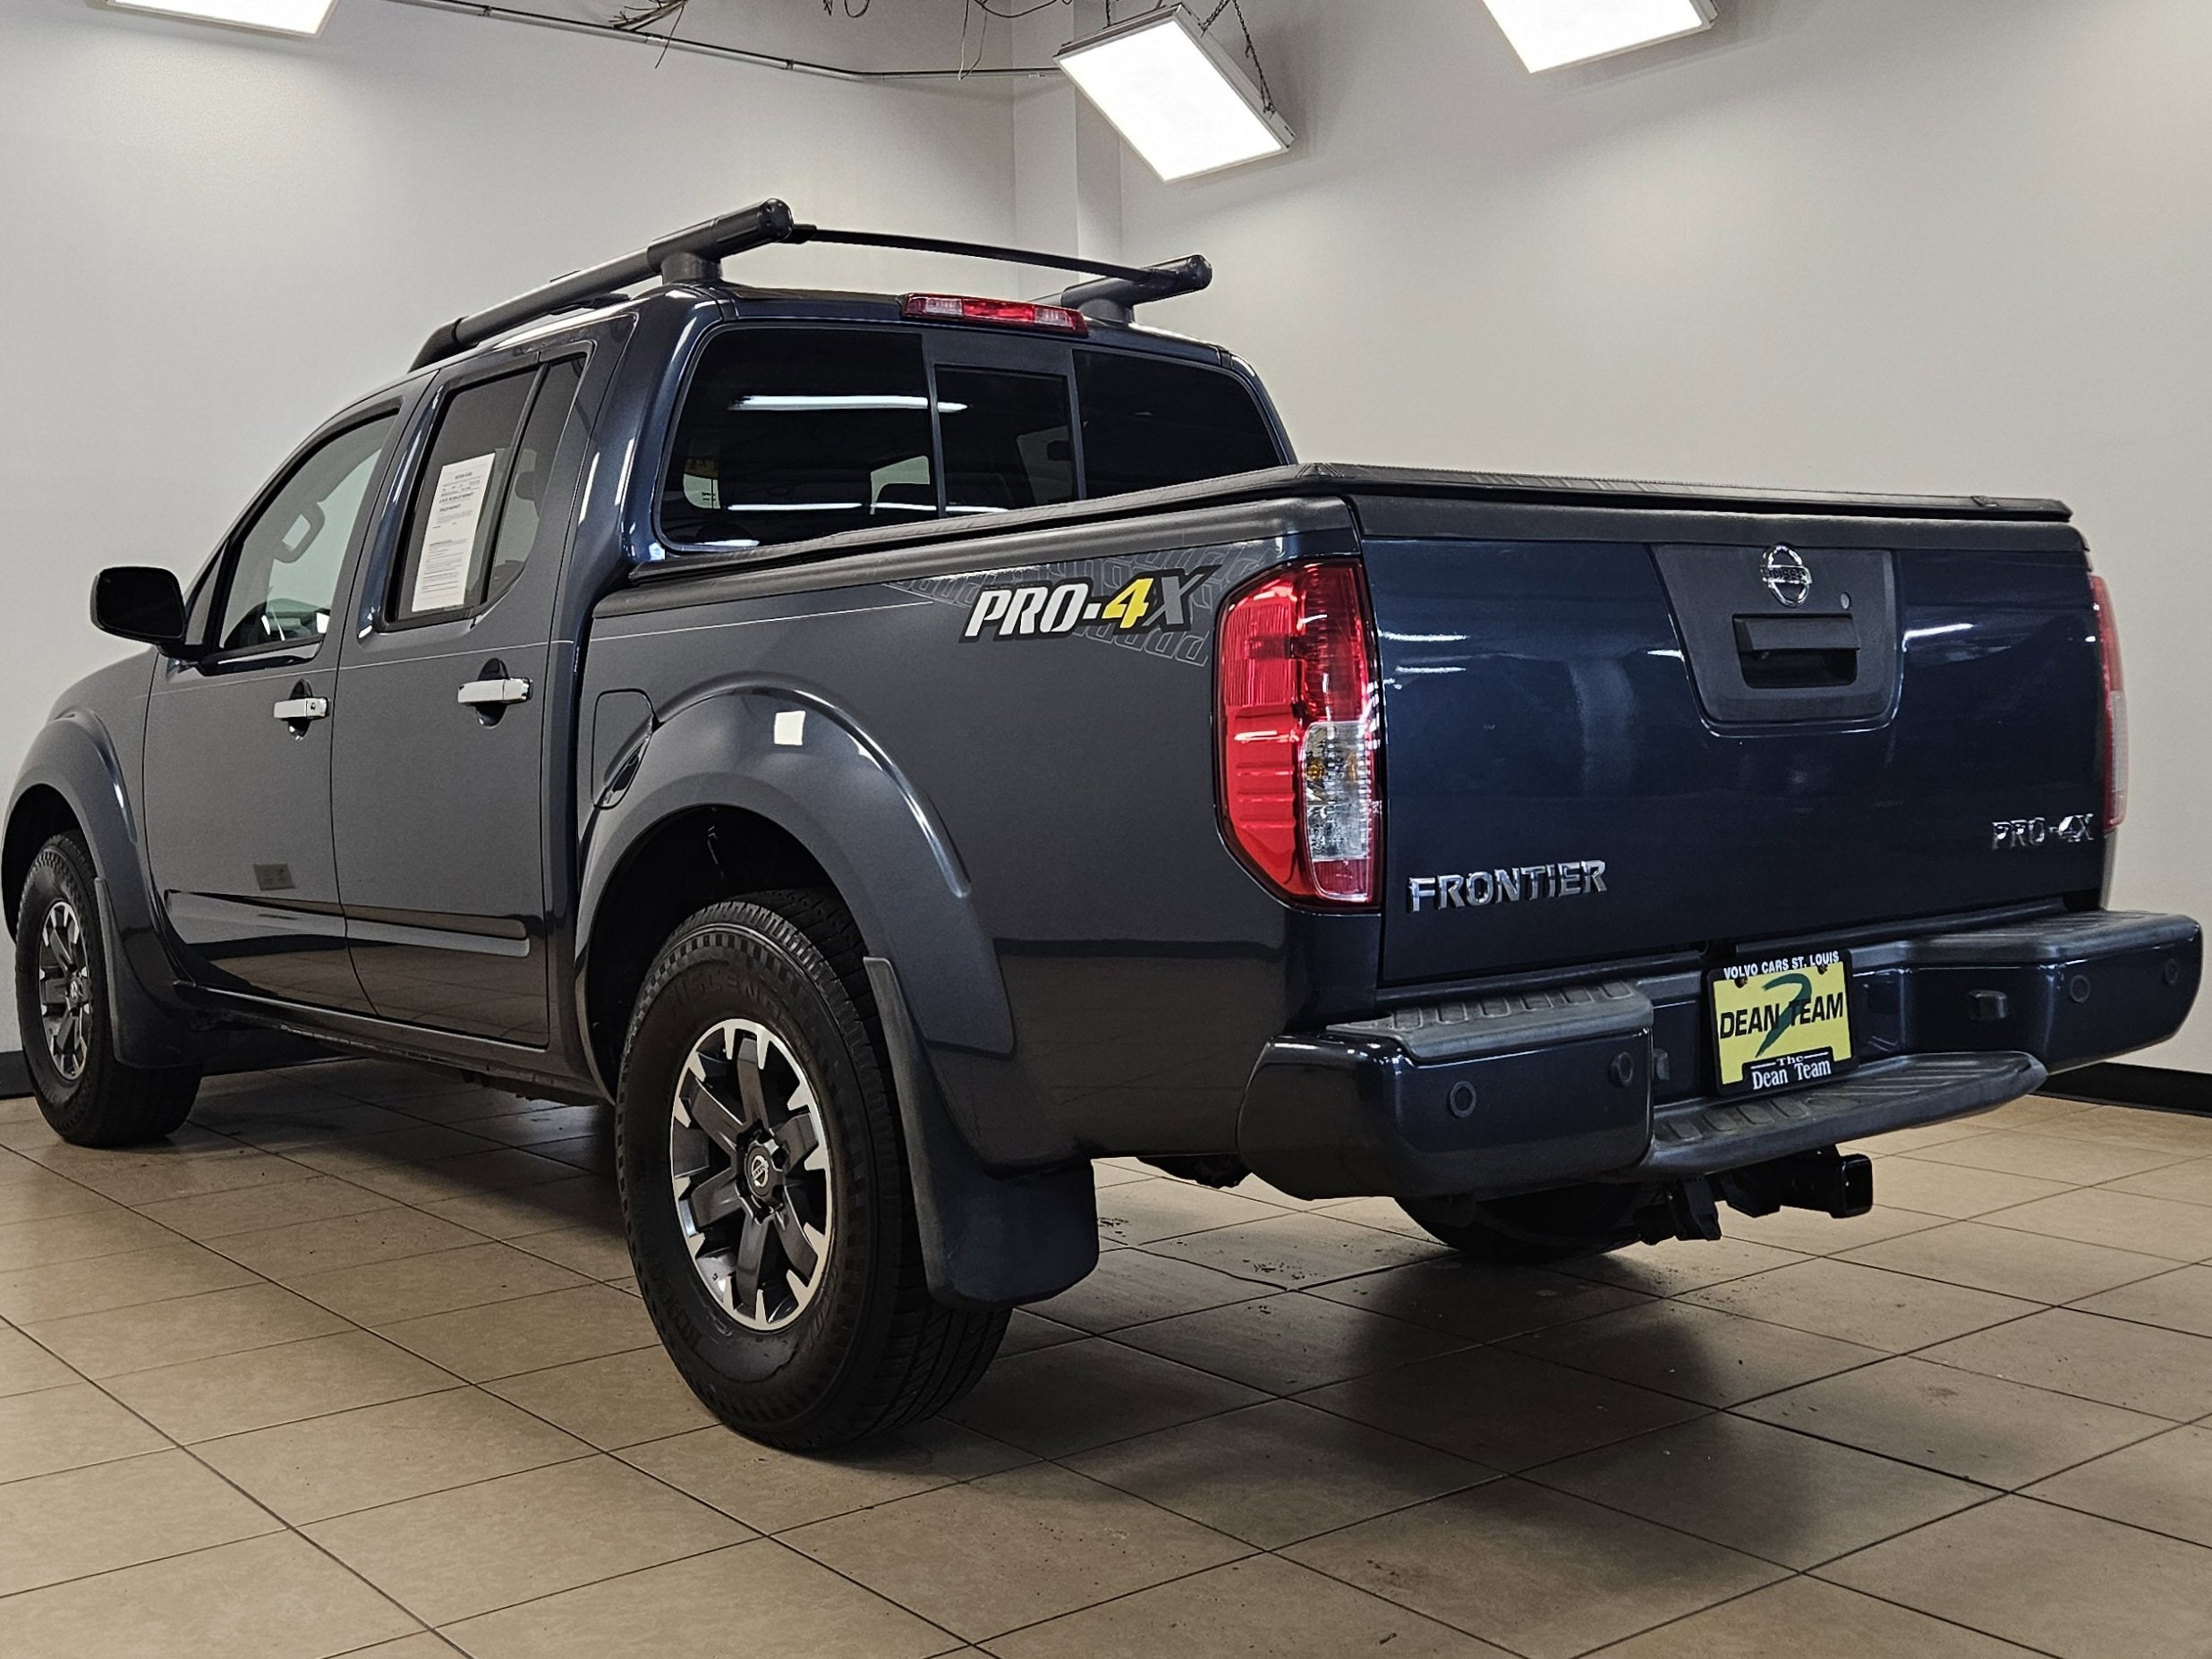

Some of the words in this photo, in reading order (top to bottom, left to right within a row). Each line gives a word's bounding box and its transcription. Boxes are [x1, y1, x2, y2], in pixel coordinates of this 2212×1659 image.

[962, 571, 1211, 638] PRO-4X
[1992, 813, 2094, 849] PRO-4X
[1408, 860, 1608, 914] FRONTIER
[1723, 963, 1758, 980] VOLVO
[1761, 958, 1789, 974] CARS
[1791, 956, 1808, 969] ST.
[1809, 950, 1840, 966] LOUIS
[1719, 1003, 1780, 1040] DEAN
[1789, 991, 1843, 1027] TEAM
[1751, 1068, 1789, 1090] Dean
[1794, 1059, 1832, 1081] Team
[1776, 1054, 1805, 1067] The
